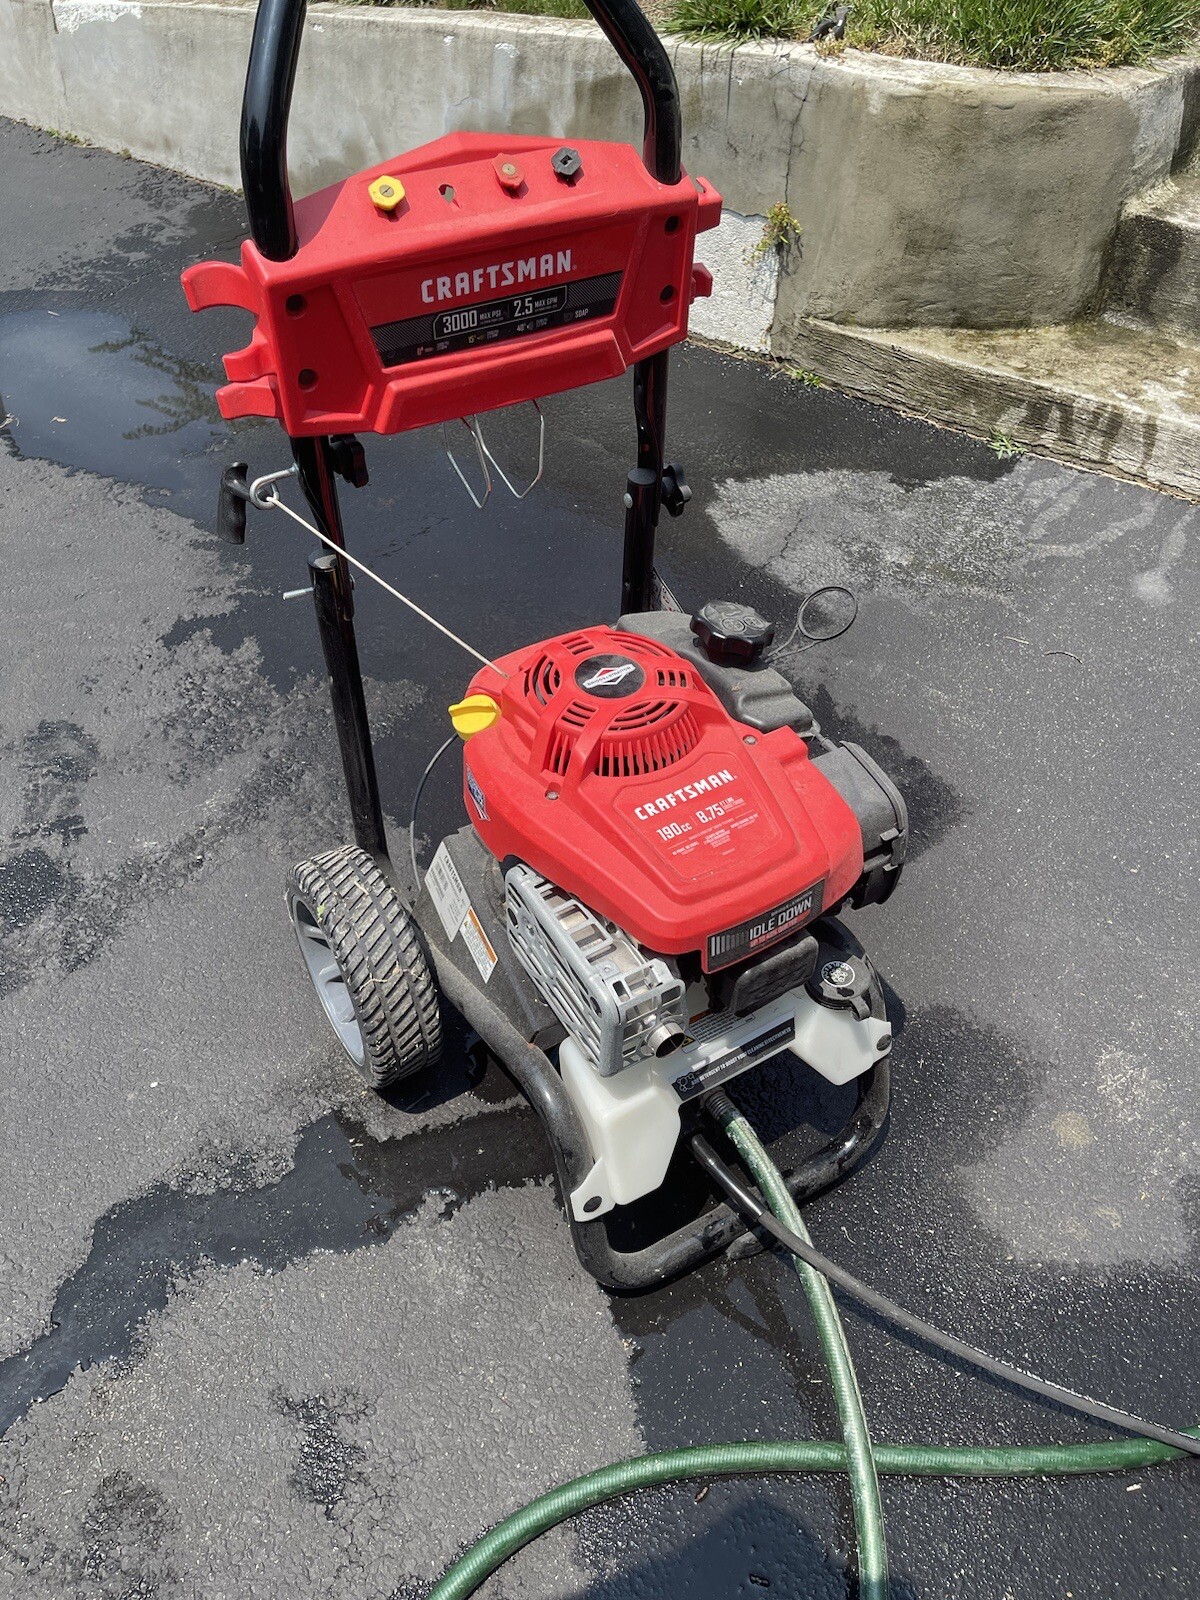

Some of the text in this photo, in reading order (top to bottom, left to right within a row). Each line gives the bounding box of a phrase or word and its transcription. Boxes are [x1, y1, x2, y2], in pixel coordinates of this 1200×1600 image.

[421, 249, 572, 304] CRAFTSMAN
[443, 310, 478, 334] 3000
[480, 312, 491, 320] MAX
[492, 310, 502, 318] PSI
[514, 297, 533, 318] 2.5
[534, 299, 546, 308] MAX
[547, 296, 558, 305] GPM
[575, 308, 589, 318] SOAP
[634, 770, 734, 820] CRAFTSMAN
[696, 803, 725, 824] 8.75
[750, 918, 776, 940] IDLE
[778, 896, 812, 926] DOWN
[698, 1066, 720, 1081] DETERGENT
